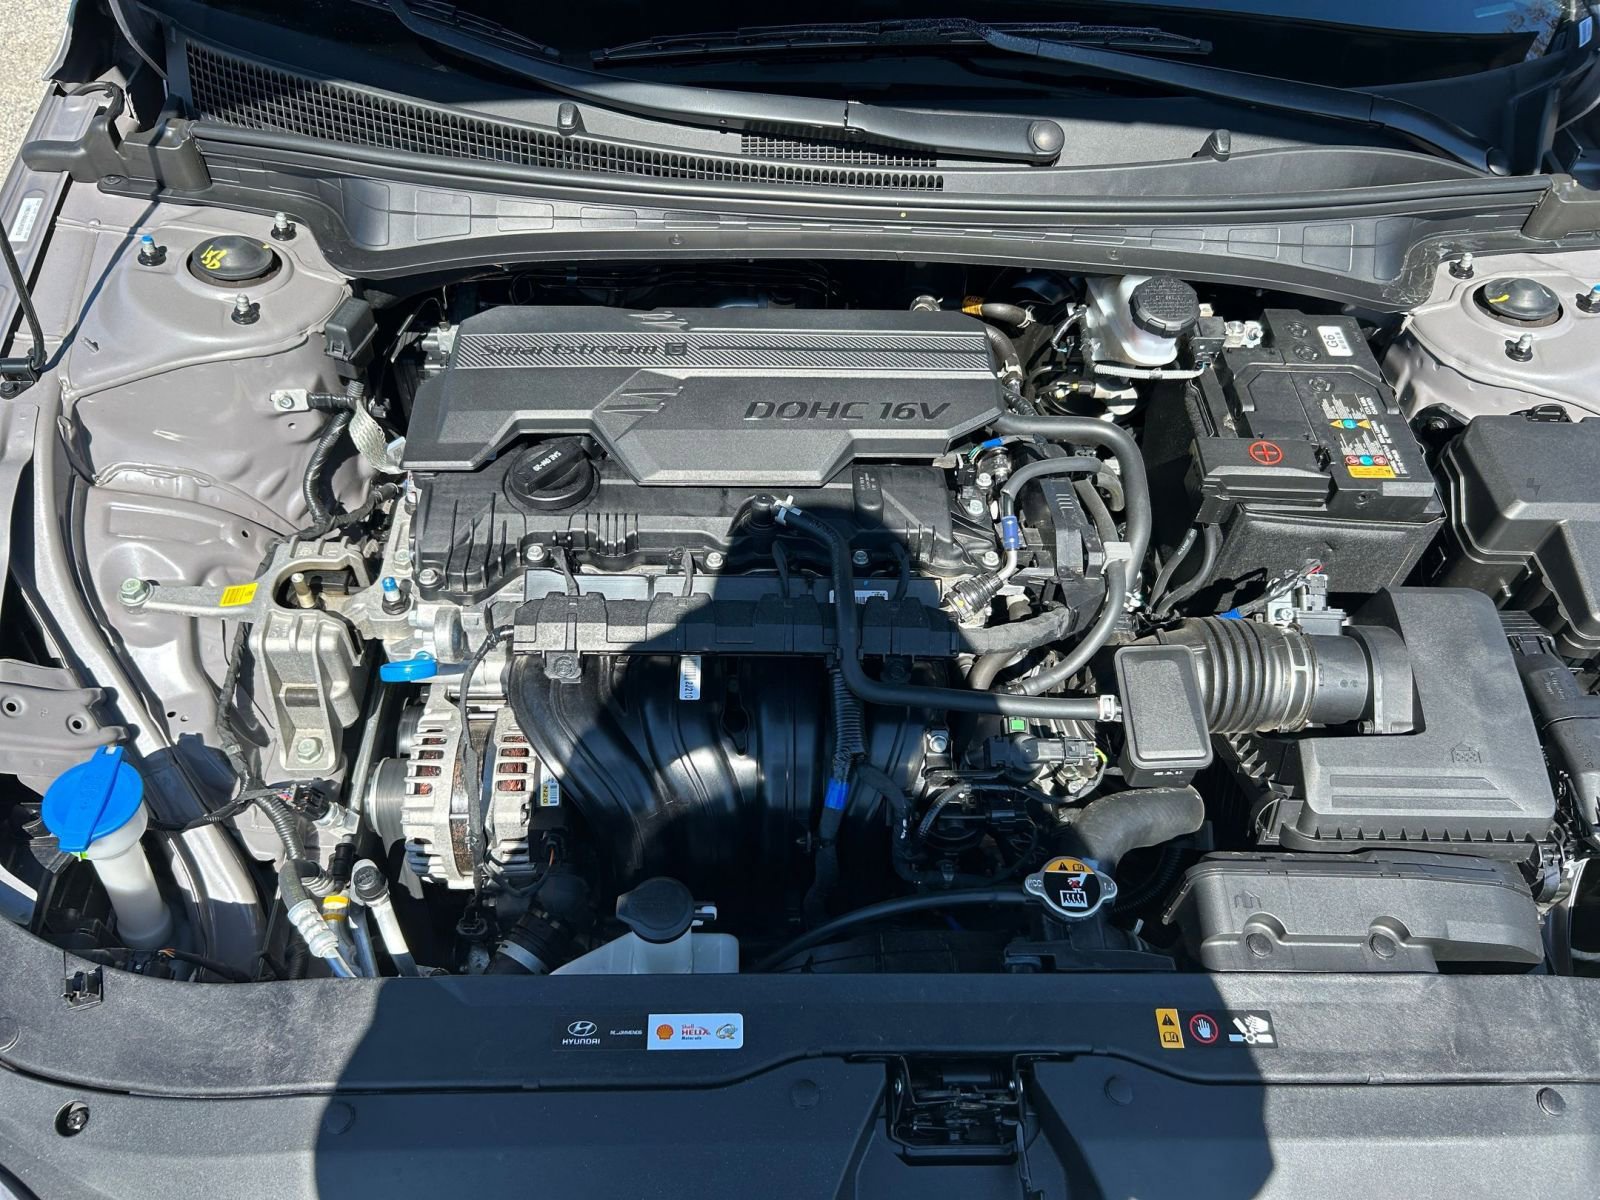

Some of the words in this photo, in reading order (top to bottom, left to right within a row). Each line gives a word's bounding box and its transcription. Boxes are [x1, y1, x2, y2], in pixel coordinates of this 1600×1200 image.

[479, 343, 658, 356] Smartstream
[744, 401, 869, 420] DOHC
[879, 402, 951, 420] 16V
[681, 1028, 709, 1036] HELIX
[562, 1038, 601, 1046] HYUNDAI
